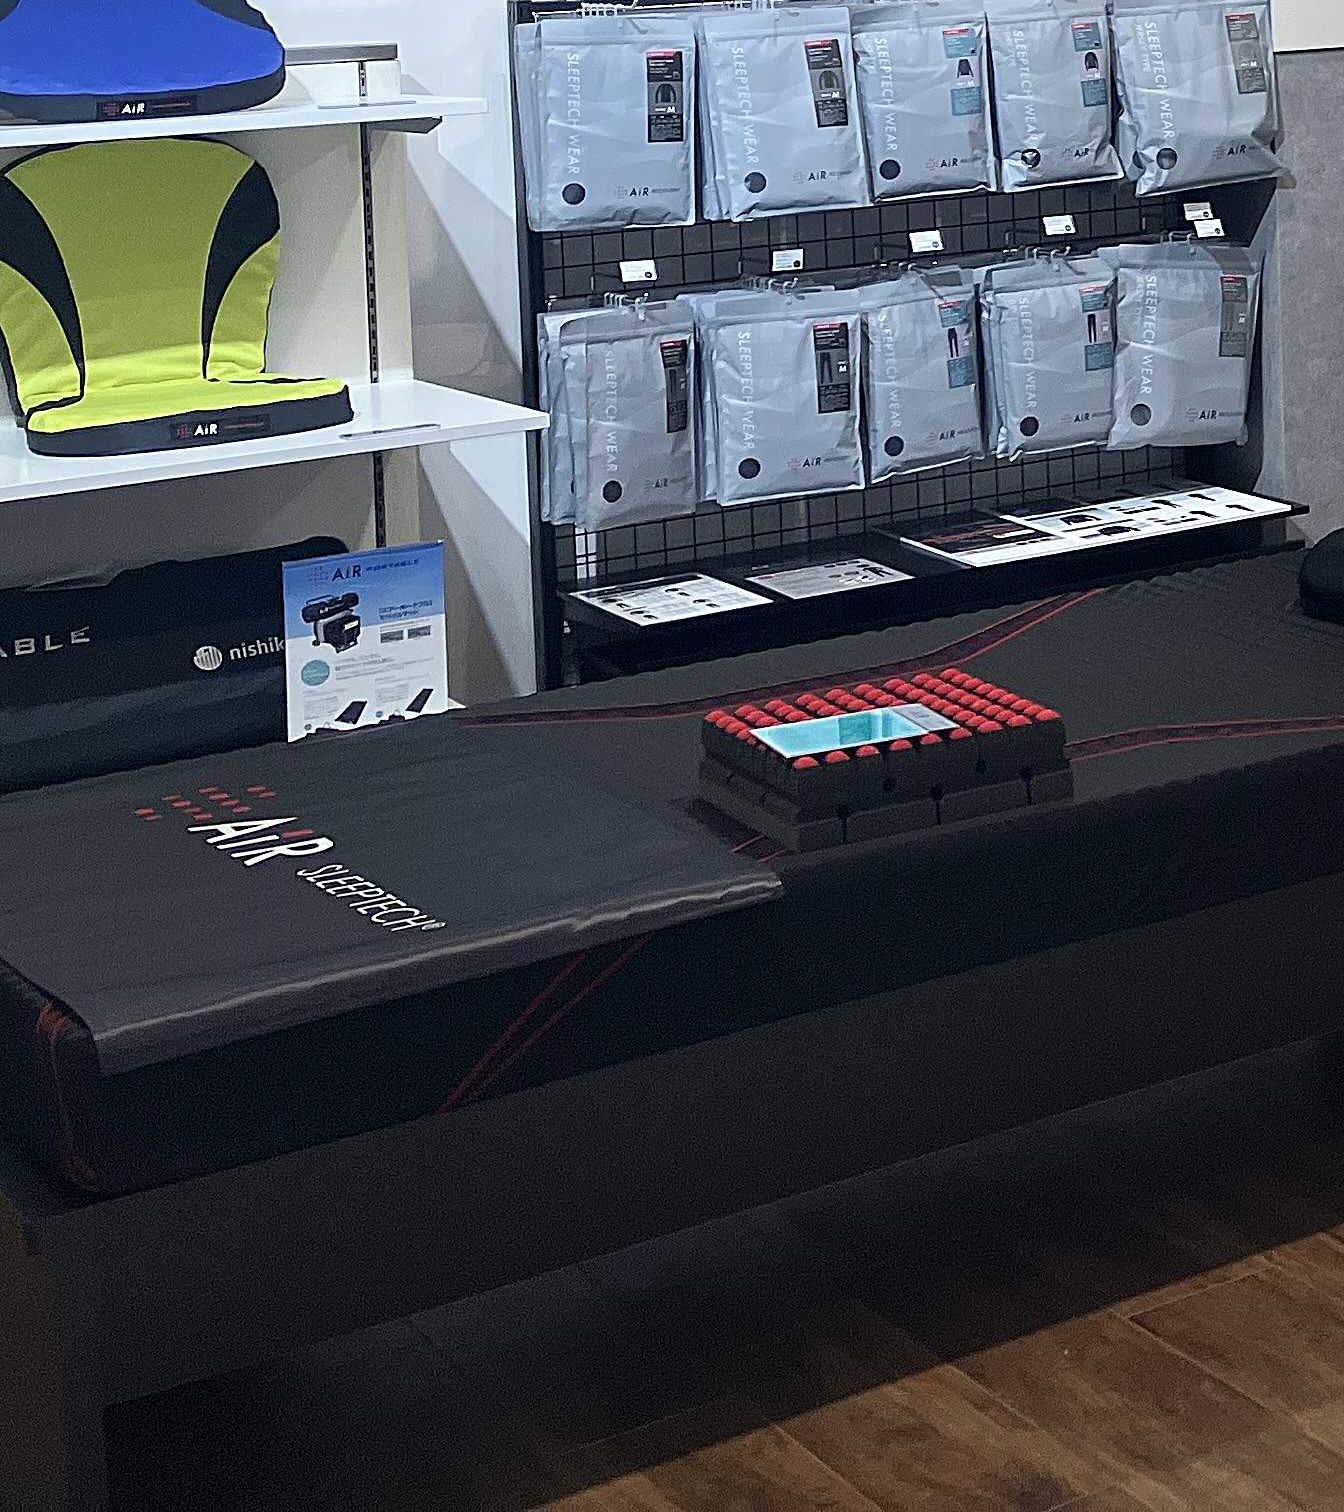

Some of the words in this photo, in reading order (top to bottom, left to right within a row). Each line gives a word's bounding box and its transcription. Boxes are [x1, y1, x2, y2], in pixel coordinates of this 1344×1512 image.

[884, 113, 898, 151] WEAR
[1160, 99, 1176, 138] WEAR
[568, 134, 581, 174] WEAR
[744, 125, 759, 164] WEAR
[1140, 354, 1153, 394] WEAR
[742, 411, 755, 449] WEAR
[607, 431, 618, 472] WEAR
